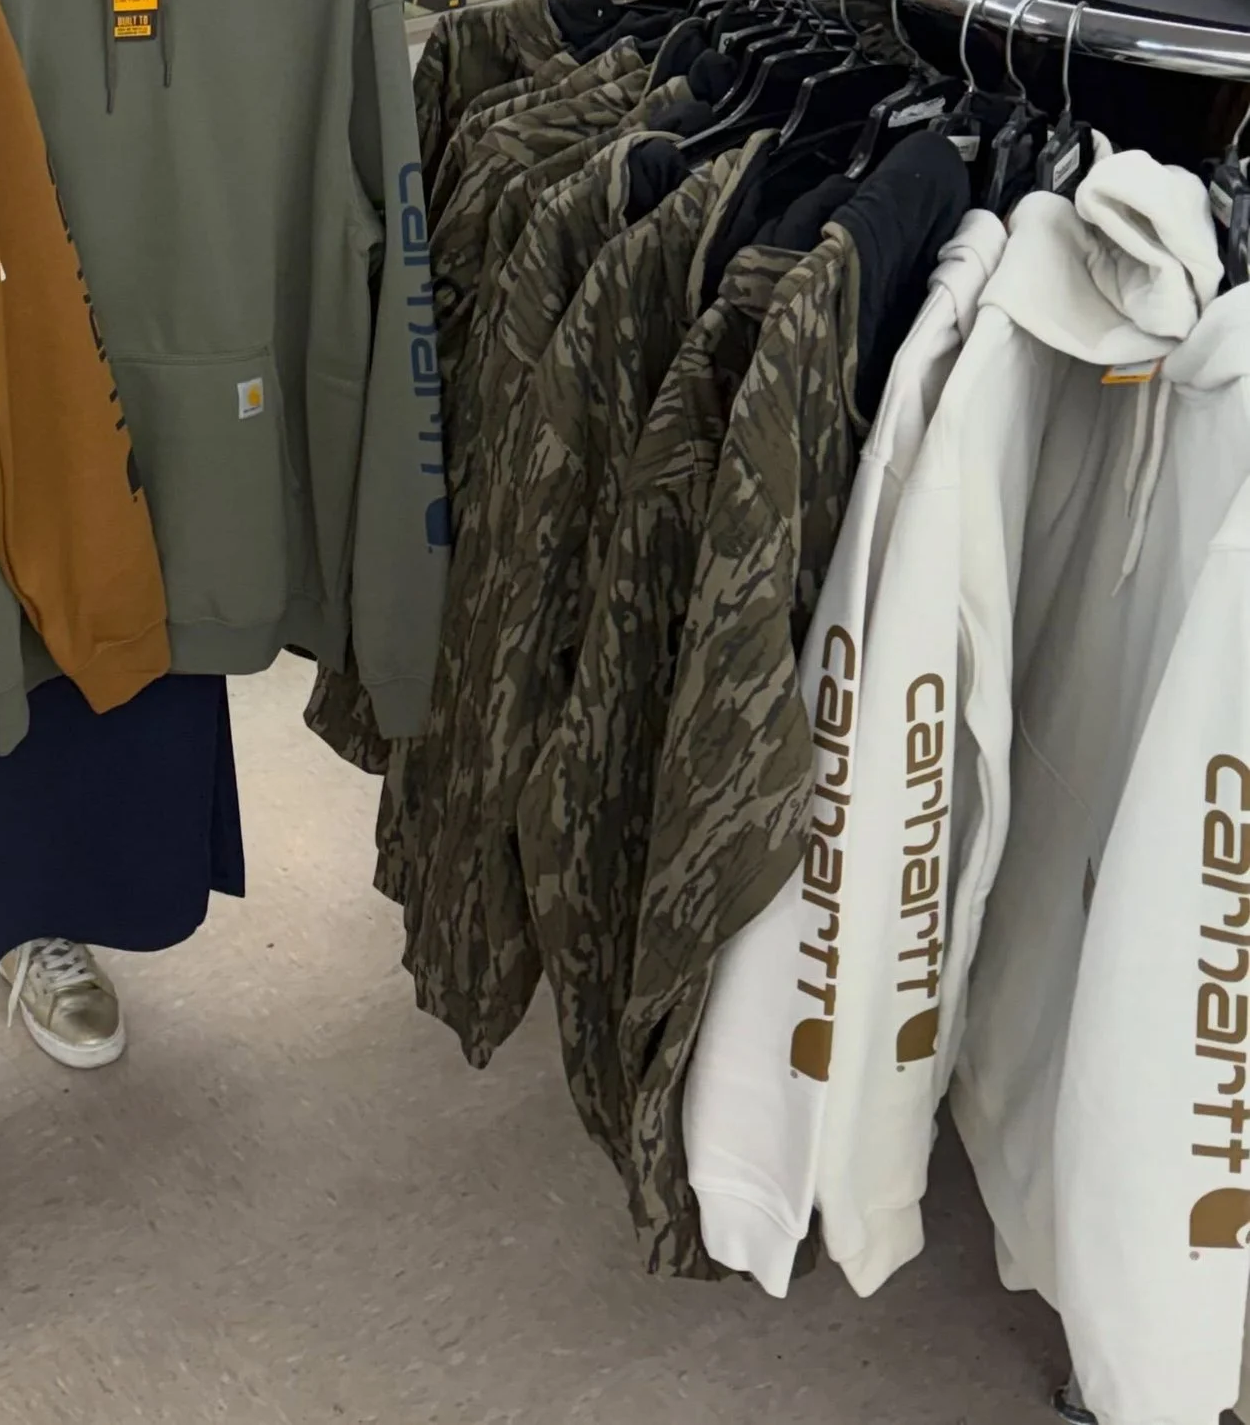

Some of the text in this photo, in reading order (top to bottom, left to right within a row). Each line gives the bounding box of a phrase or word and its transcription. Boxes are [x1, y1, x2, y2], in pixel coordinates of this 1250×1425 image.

[139, 15, 149, 25] TO
[797, 624, 856, 1016] carhartt
[896, 672, 948, 999] carhartt
[1190, 753, 1250, 1174] carhartt
